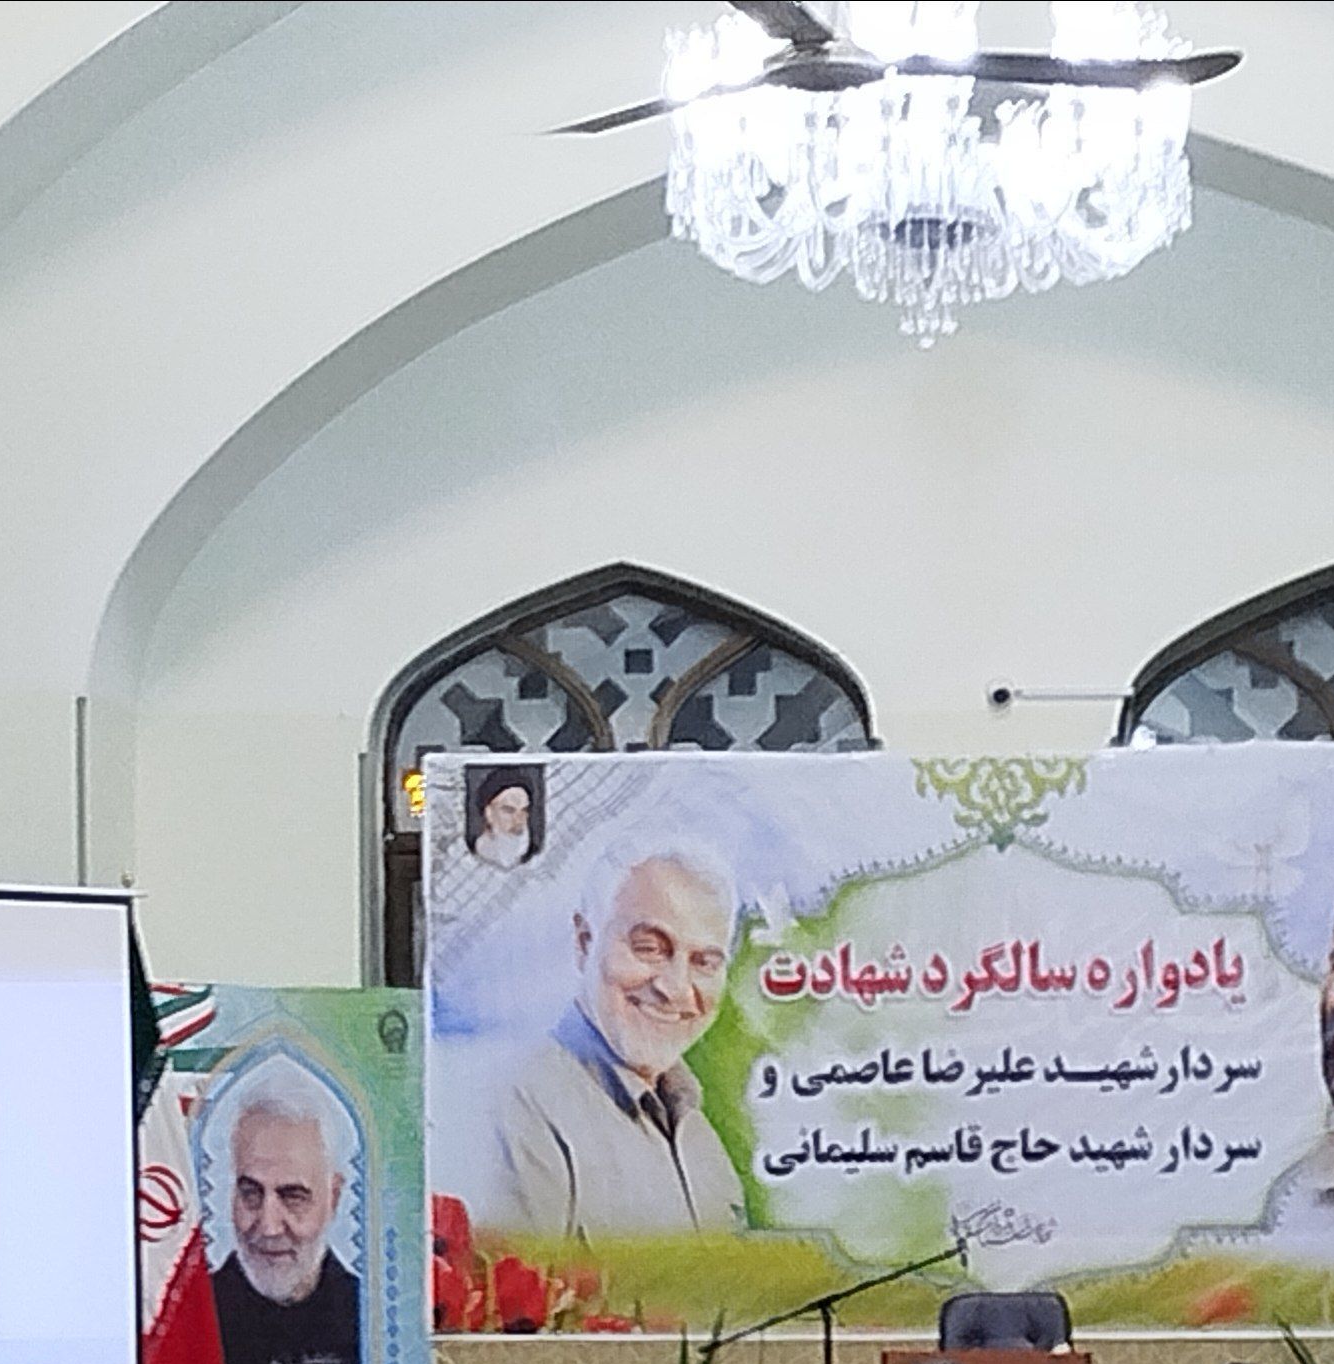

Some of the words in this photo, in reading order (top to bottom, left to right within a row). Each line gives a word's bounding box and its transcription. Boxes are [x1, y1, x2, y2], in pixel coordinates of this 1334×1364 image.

[763, 943, 911, 1003] شهادت
[921, 941, 1075, 1010] سالگرد
[1085, 938, 1247, 1008] یادواره
[758, 1065, 777, 1098] و
[792, 1048, 914, 1098] عاصمی
[1043, 1046, 1158, 1093] شهید
[1159, 1045, 1262, 1095] سردار
[763, 1124, 898, 1177] سلیمانی
[904, 1124, 983, 1175] قاسم
[990, 1127, 1061, 1174] حاج
[1069, 1126, 1153, 1171] شهید
[1159, 1126, 1262, 1174] سردار
